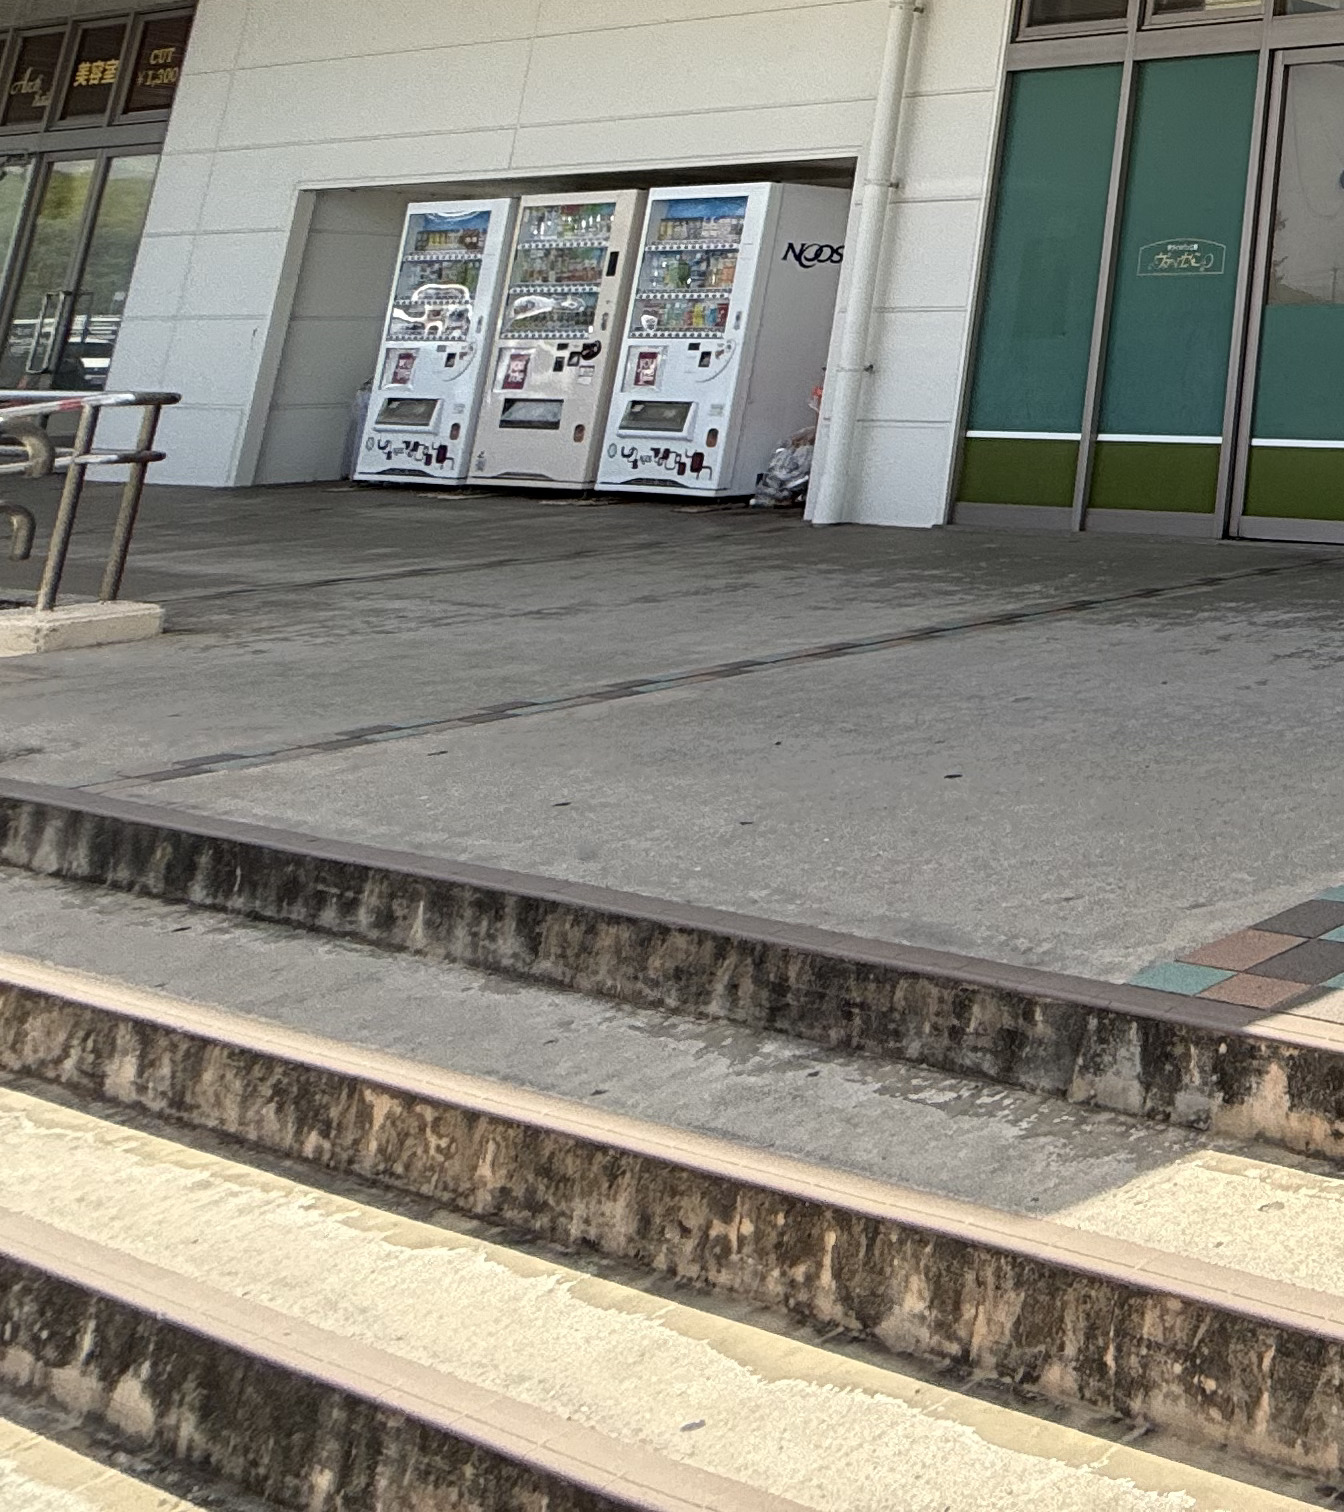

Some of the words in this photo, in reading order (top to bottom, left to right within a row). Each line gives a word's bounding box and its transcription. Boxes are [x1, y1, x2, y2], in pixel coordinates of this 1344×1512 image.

[150, 47, 175, 65] CUT
[73, 59, 120, 87] 美容室
